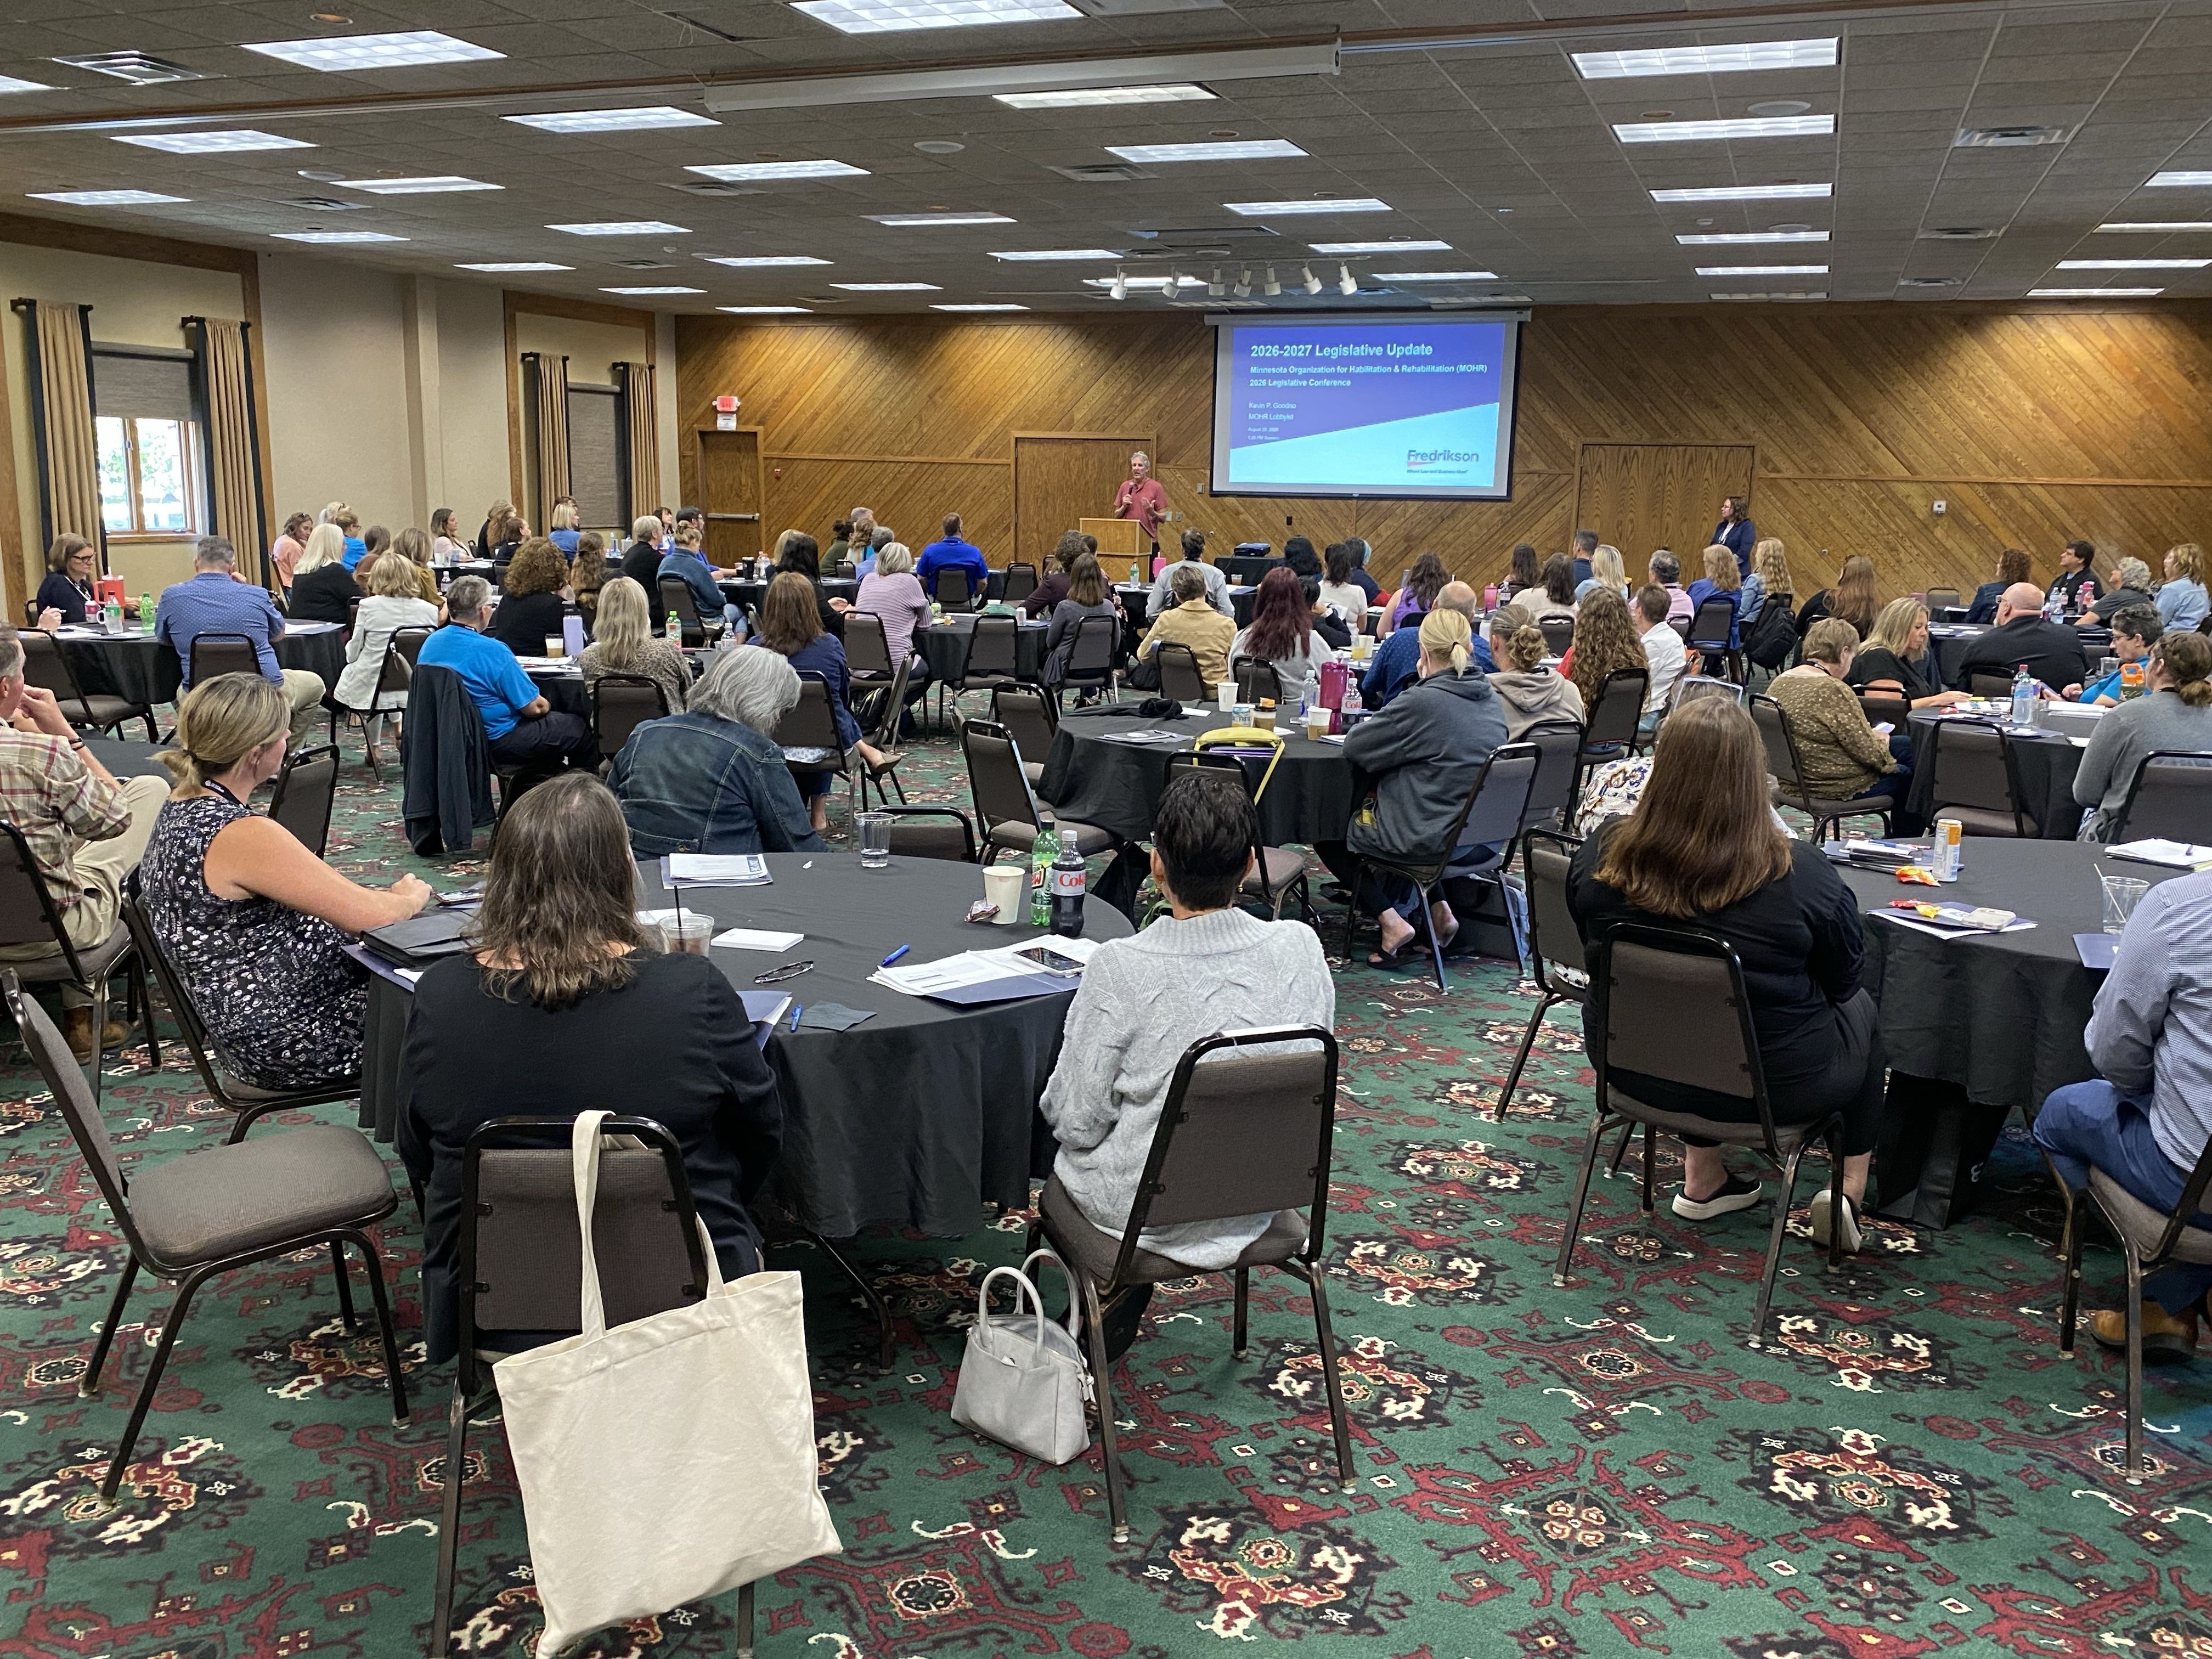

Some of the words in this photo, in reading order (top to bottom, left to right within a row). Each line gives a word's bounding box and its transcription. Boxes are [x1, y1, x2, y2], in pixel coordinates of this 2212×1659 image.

[1251, 345, 1312, 357] 2026-2027
[1316, 344, 1383, 359] Legislative
[1387, 343, 1433, 358] Update
[1289, 365, 1335, 375] Organization
[1456, 364, 1487, 374] (MOHR)
[1268, 379, 1307, 388] Legislative
[1269, 413, 1294, 421] Lobbyist
[1408, 450, 1479, 461] Fredrikson
[1059, 873, 1085, 887] Cok
